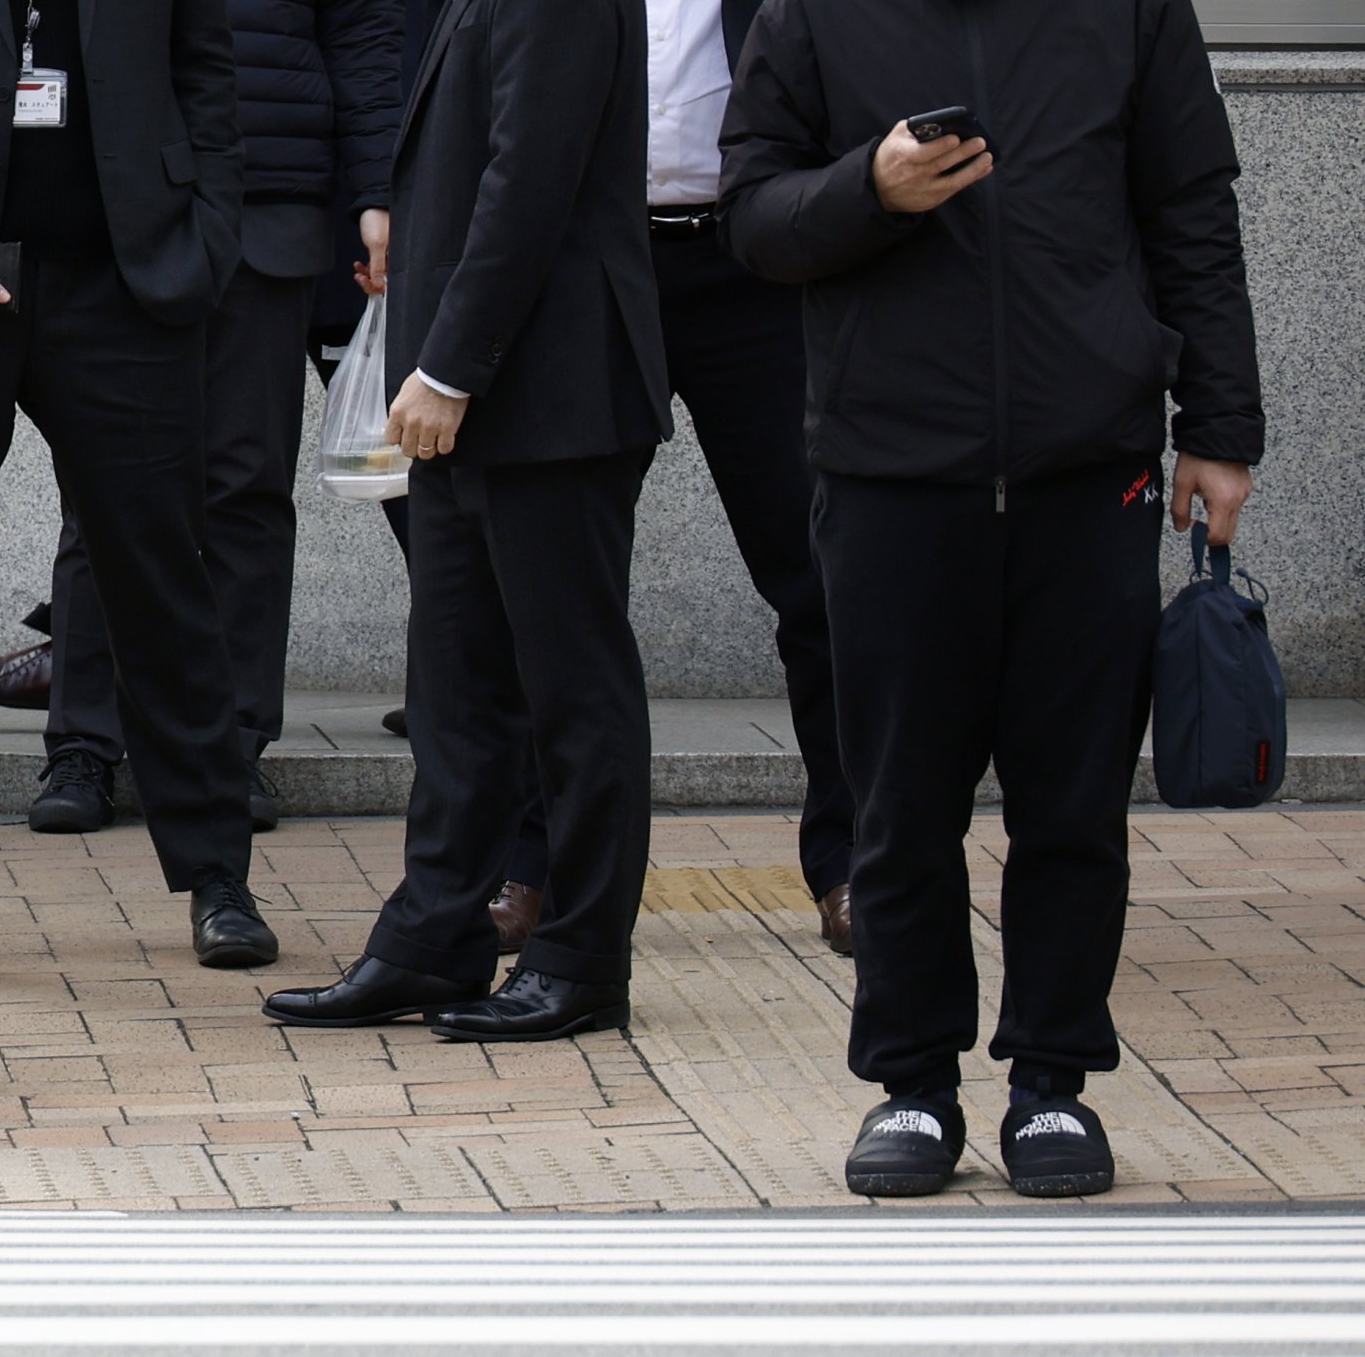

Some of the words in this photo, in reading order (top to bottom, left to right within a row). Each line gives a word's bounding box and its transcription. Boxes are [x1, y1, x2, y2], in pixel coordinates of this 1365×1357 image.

[894, 1110, 920, 1118] THE
[1031, 1112, 1058, 1122] THE
[873, 1116, 919, 1132] NORTH
[884, 1124, 917, 1133] FACE
[1015, 1117, 1060, 1141] NORTH
[1027, 1125, 1061, 1138] FACE
